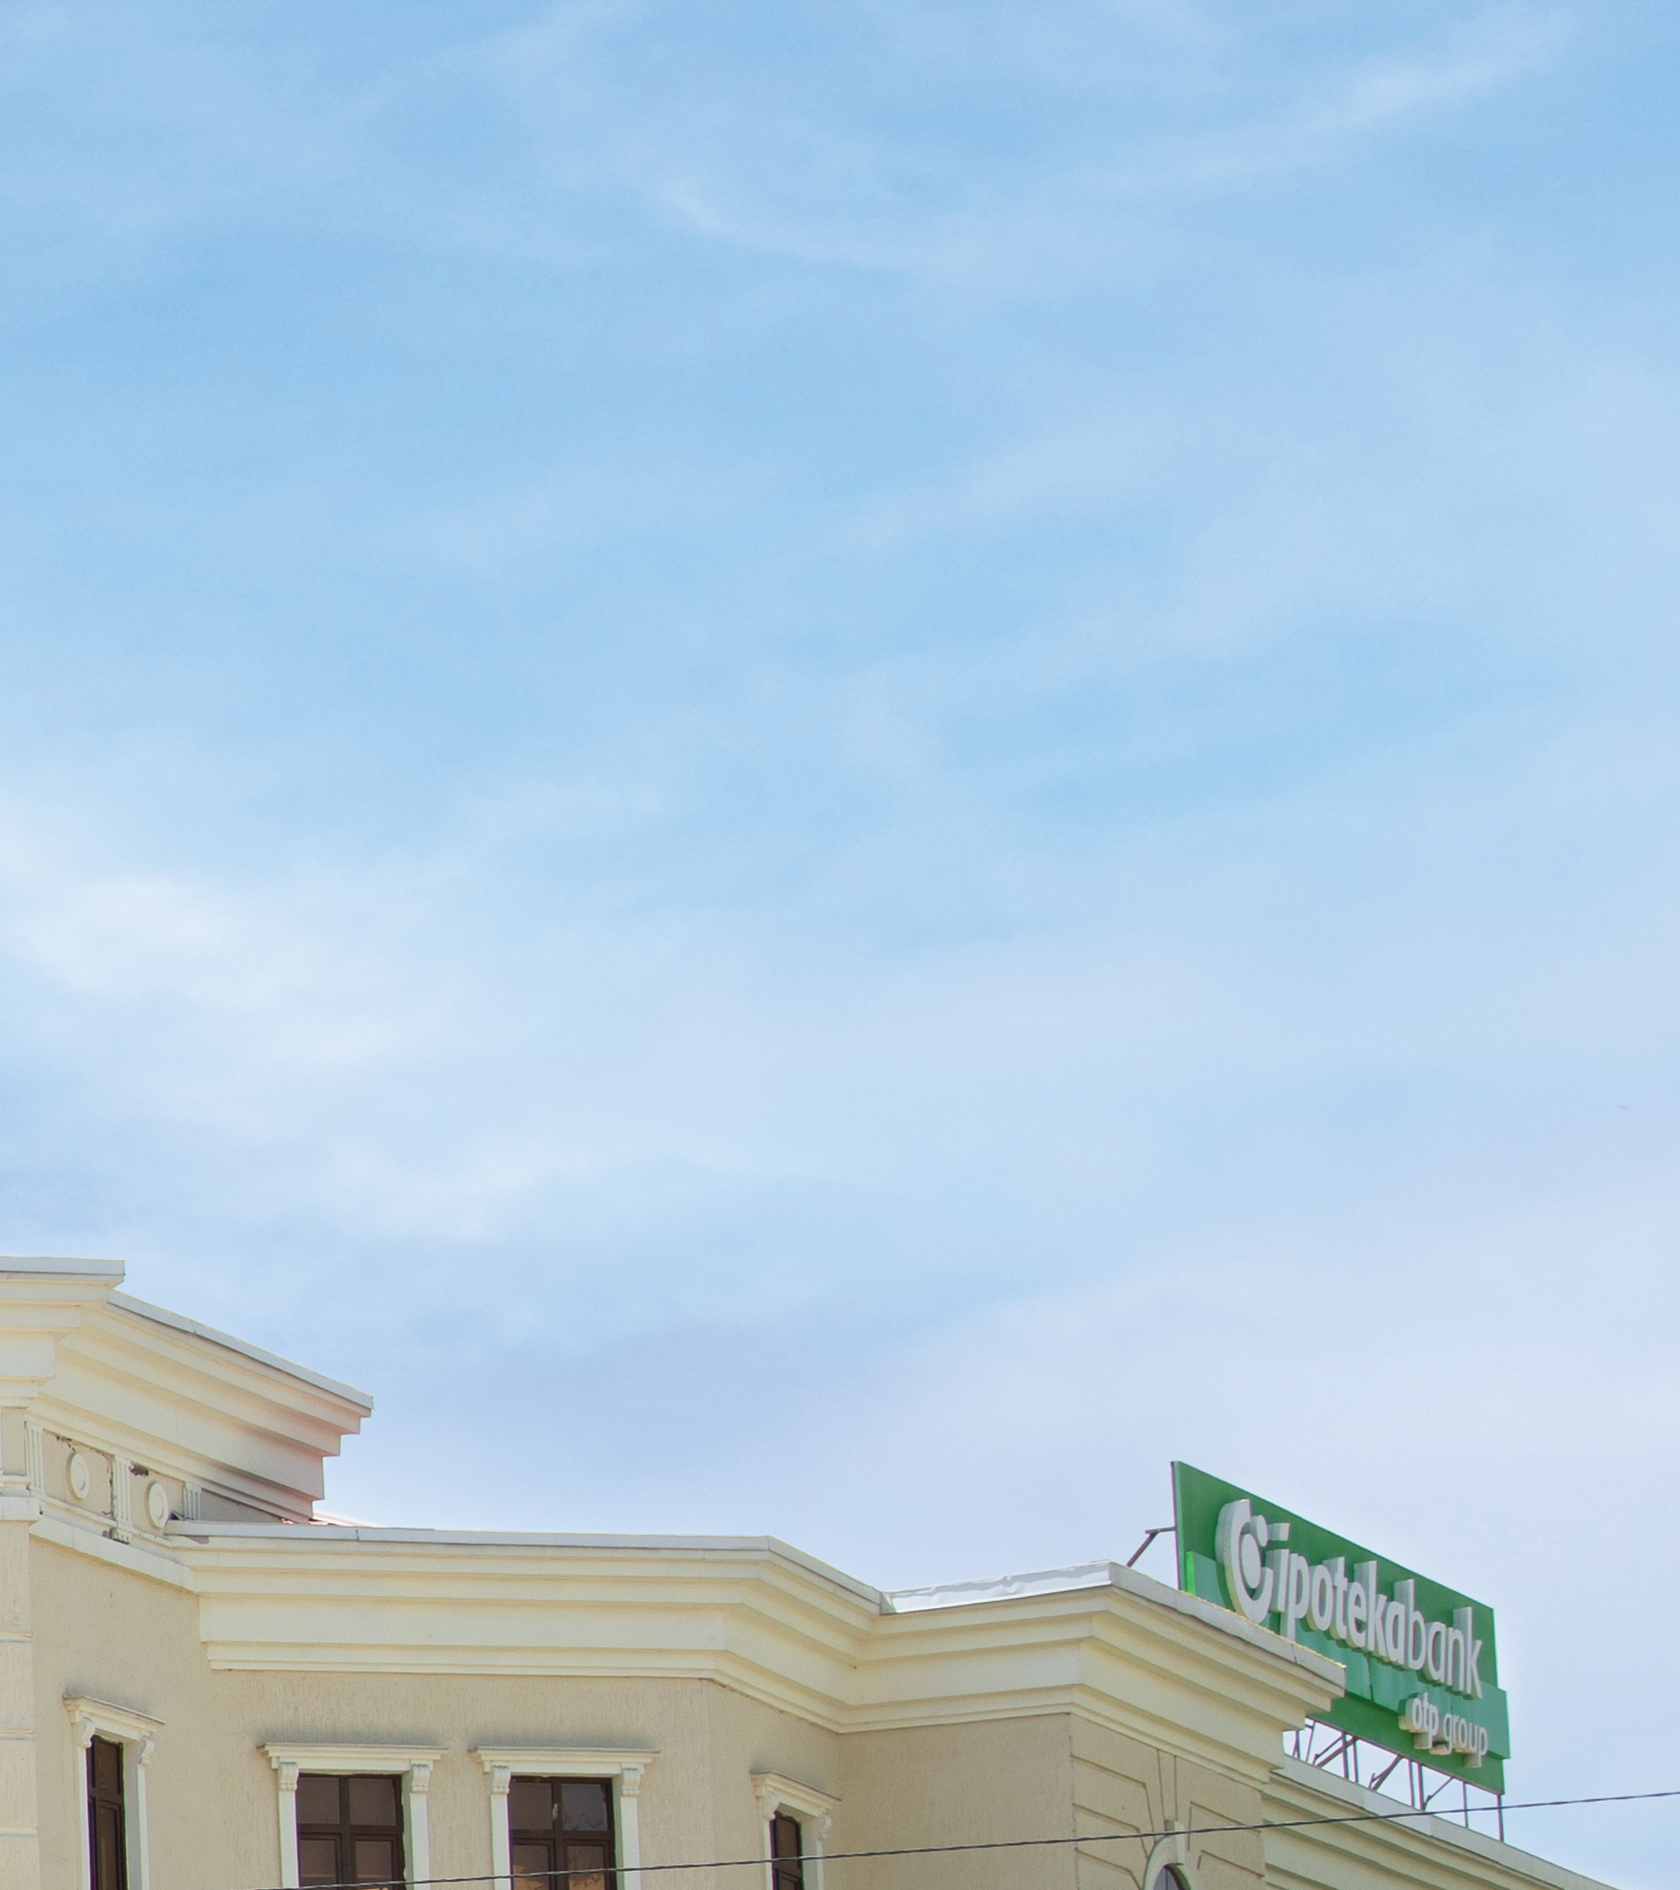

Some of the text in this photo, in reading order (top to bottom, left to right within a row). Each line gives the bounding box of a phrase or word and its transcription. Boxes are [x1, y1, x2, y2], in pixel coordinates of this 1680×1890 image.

[1269, 1522, 1482, 1699] ipotekabank
[1406, 1692, 1488, 1768] otp group
